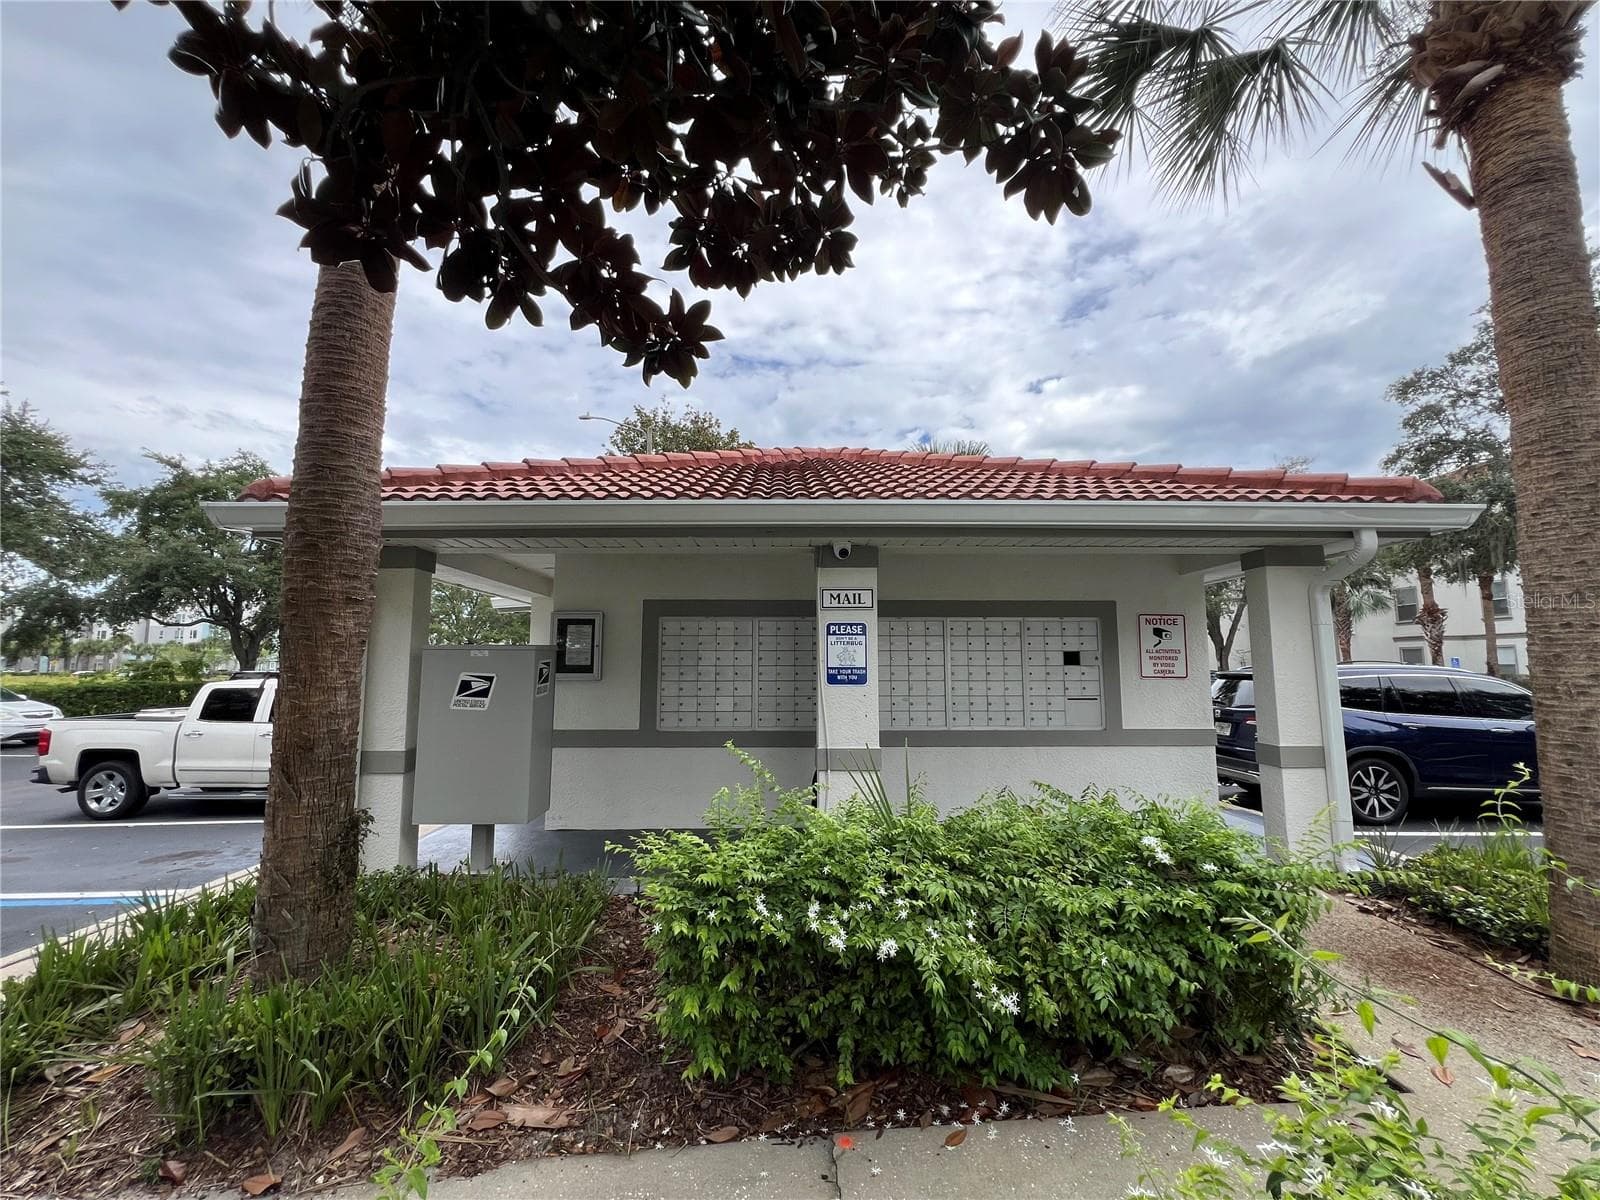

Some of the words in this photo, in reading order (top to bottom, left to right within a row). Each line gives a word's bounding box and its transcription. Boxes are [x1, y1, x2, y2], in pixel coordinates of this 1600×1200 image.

[829, 592, 866, 605] MAIL
[1145, 617, 1179, 626] NOTICE
[830, 625, 863, 634] PLEASE
